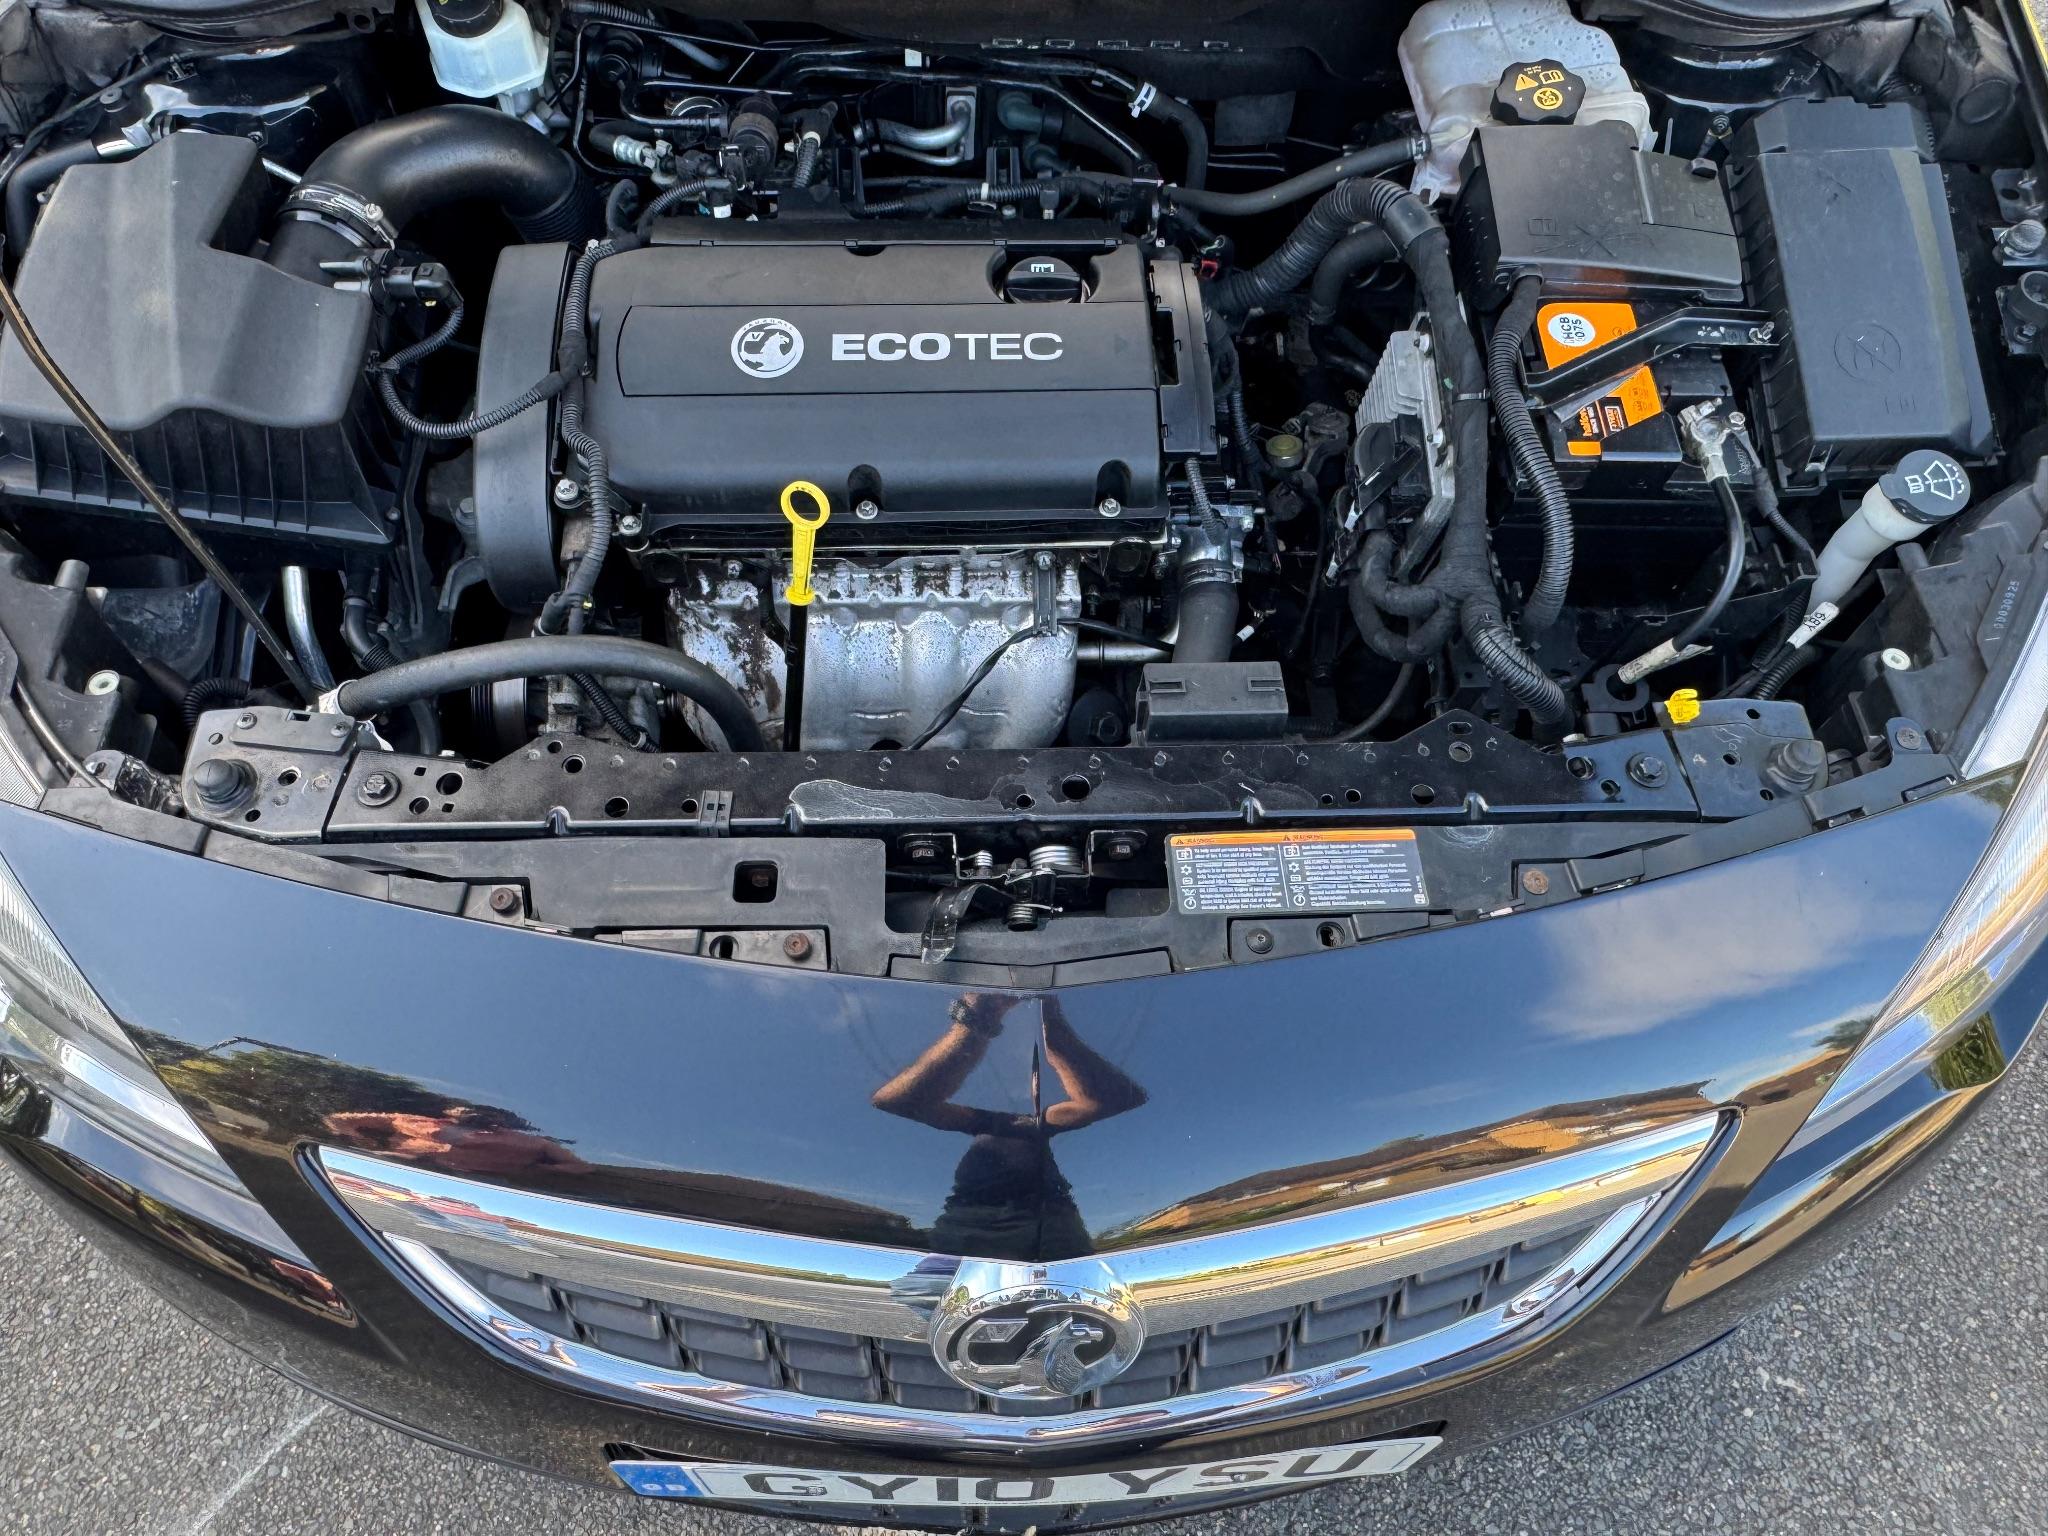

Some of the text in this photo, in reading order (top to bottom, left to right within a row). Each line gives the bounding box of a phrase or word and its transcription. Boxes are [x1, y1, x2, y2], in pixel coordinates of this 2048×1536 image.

[1559, 317, 1574, 339] HCB
[1571, 319, 1585, 338] 075
[831, 332, 1063, 361] ECOTEC
[743, 1448, 1381, 1503] GY10 YSU
